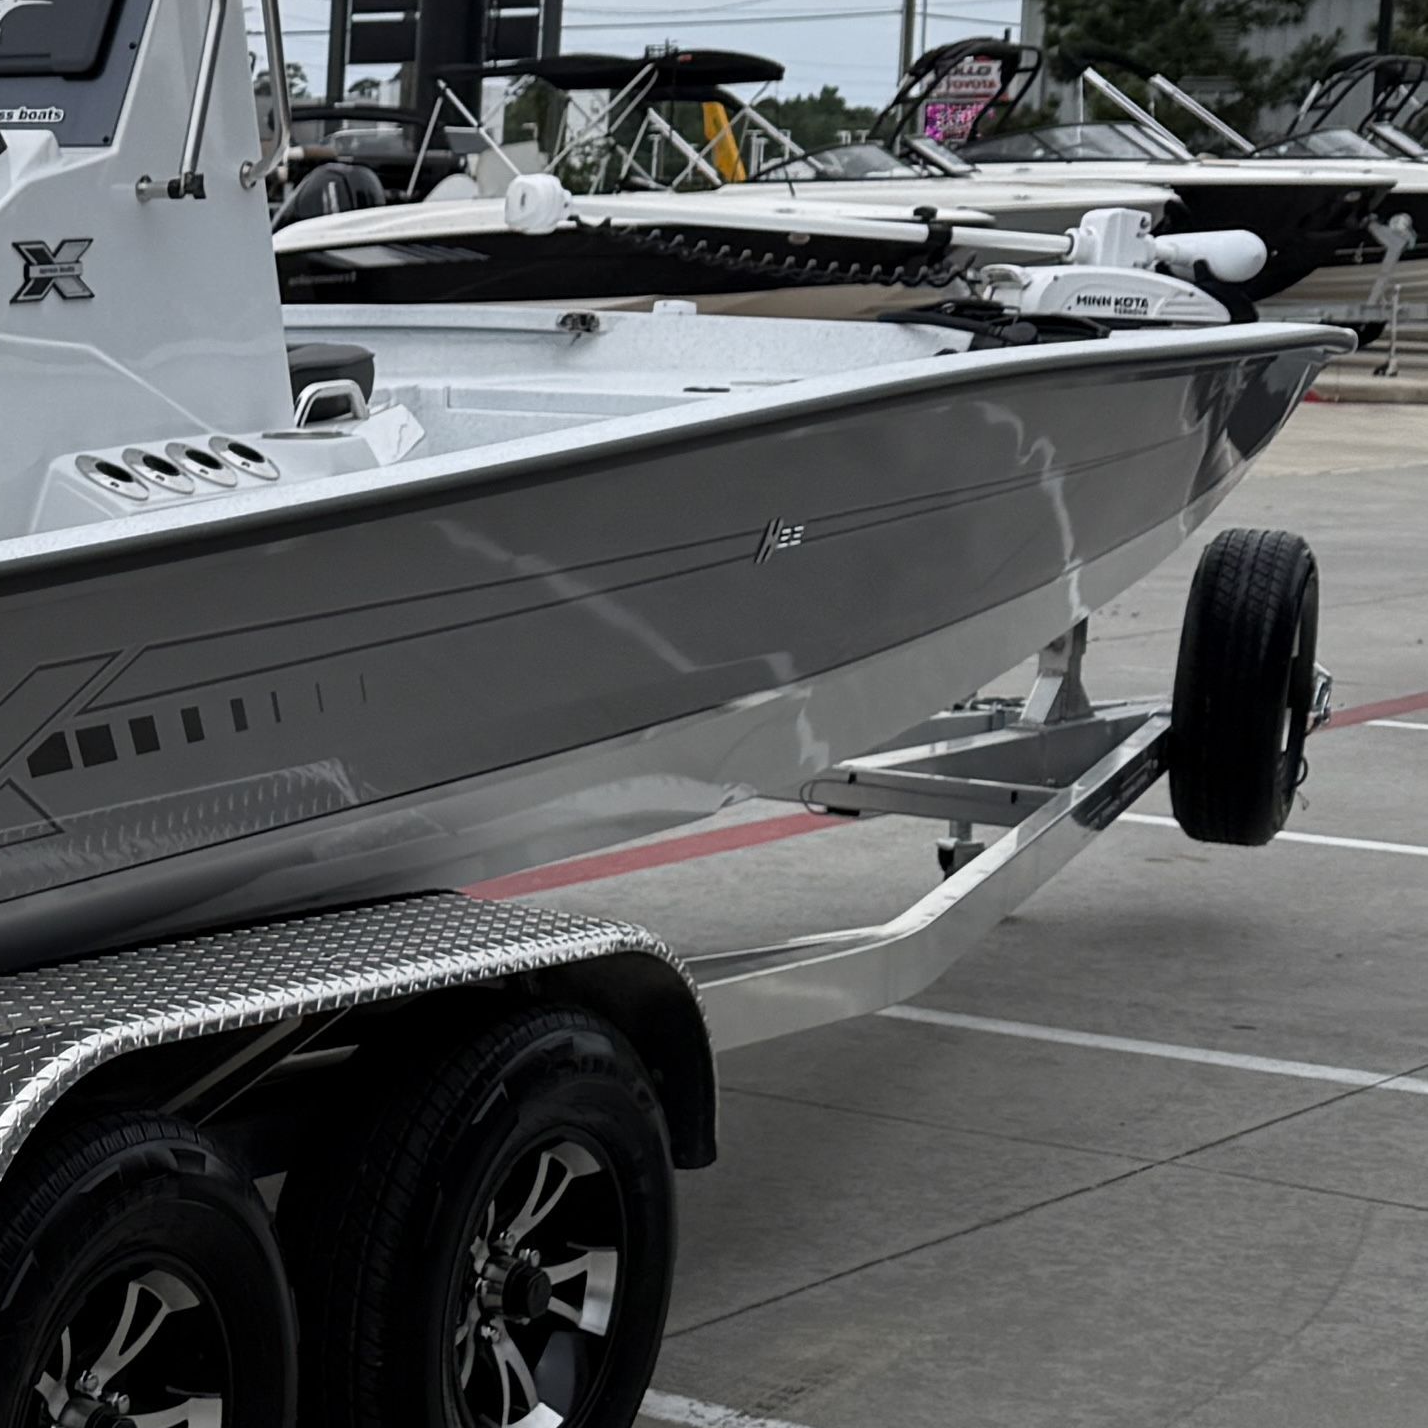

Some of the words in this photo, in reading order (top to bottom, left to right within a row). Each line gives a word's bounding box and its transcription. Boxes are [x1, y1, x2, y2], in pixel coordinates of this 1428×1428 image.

[951, 79, 997, 90] OYOTA
[18, 108, 62, 120] boats
[1076, 294, 1112, 307] MINN
[1114, 296, 1149, 309] KOTA
